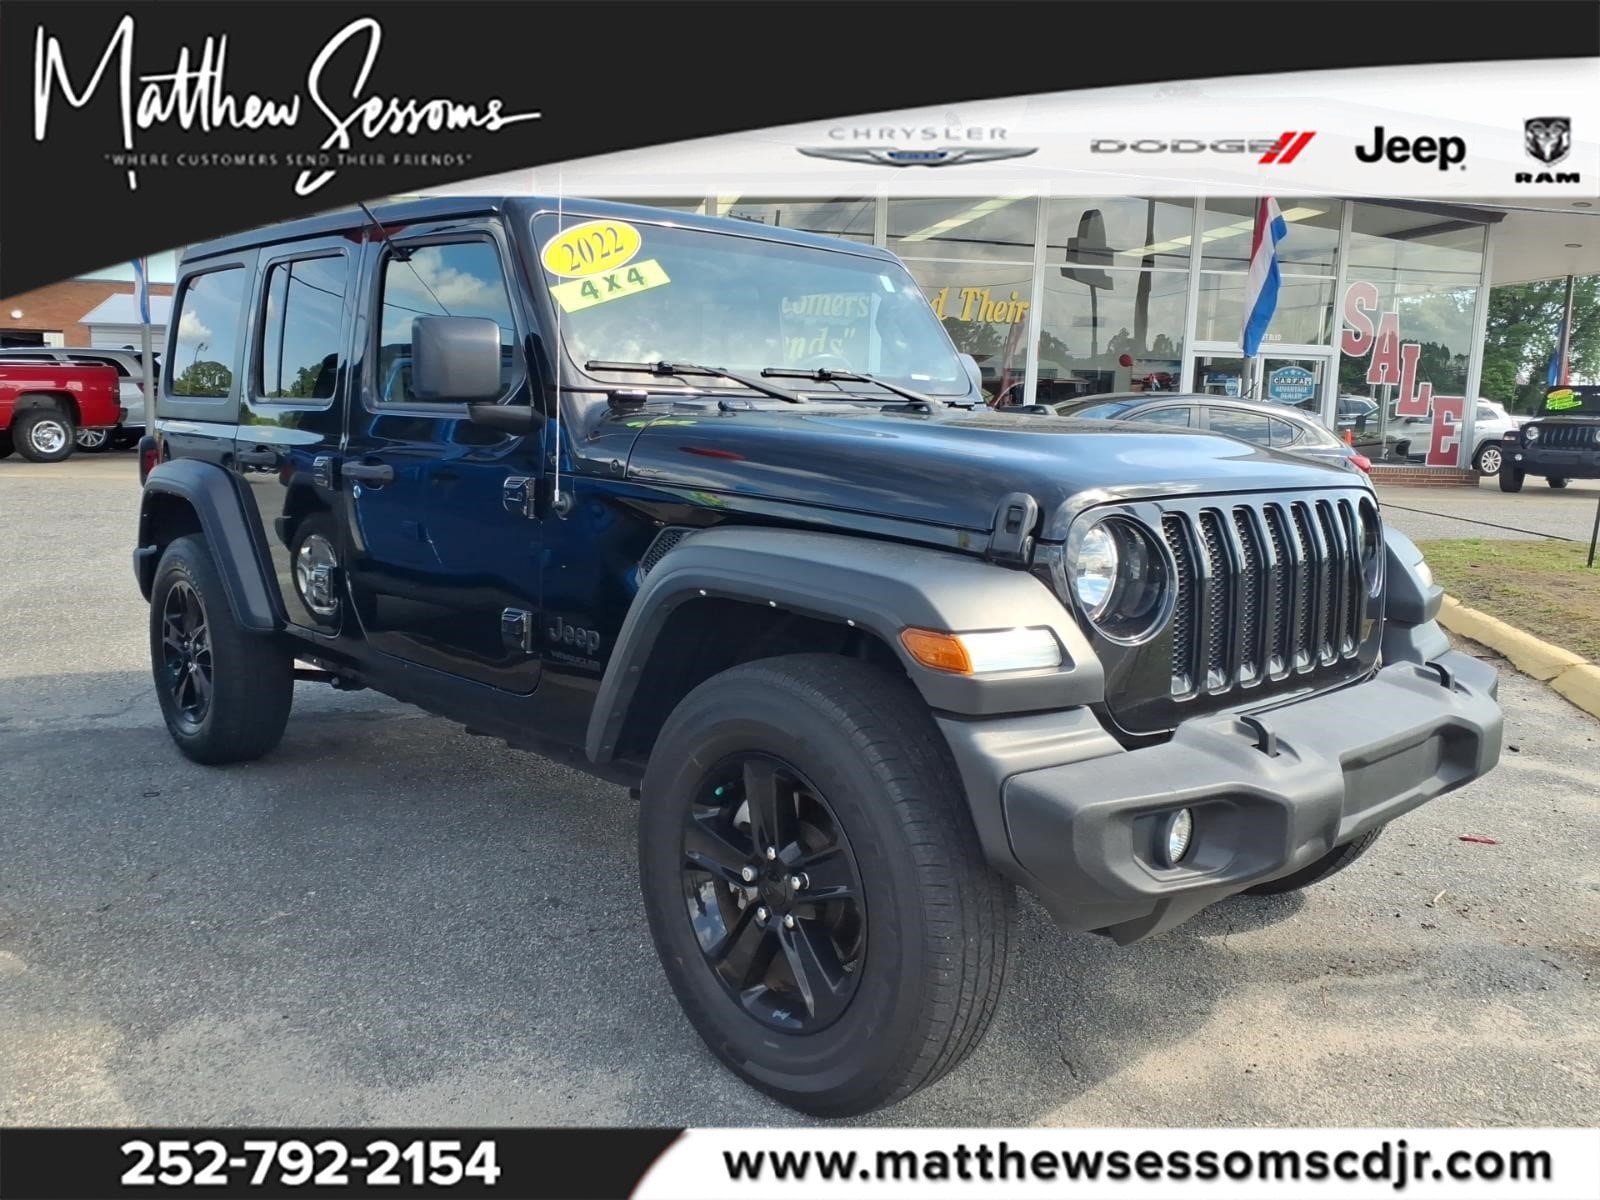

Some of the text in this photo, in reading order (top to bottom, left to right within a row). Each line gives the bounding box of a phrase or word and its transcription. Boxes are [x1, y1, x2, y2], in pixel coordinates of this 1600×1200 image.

[562, 226, 624, 272] 2022
[958, 286, 1031, 324] Their
[1340, 281, 1466, 468] SALE
[549, 616, 600, 656] Jeep
